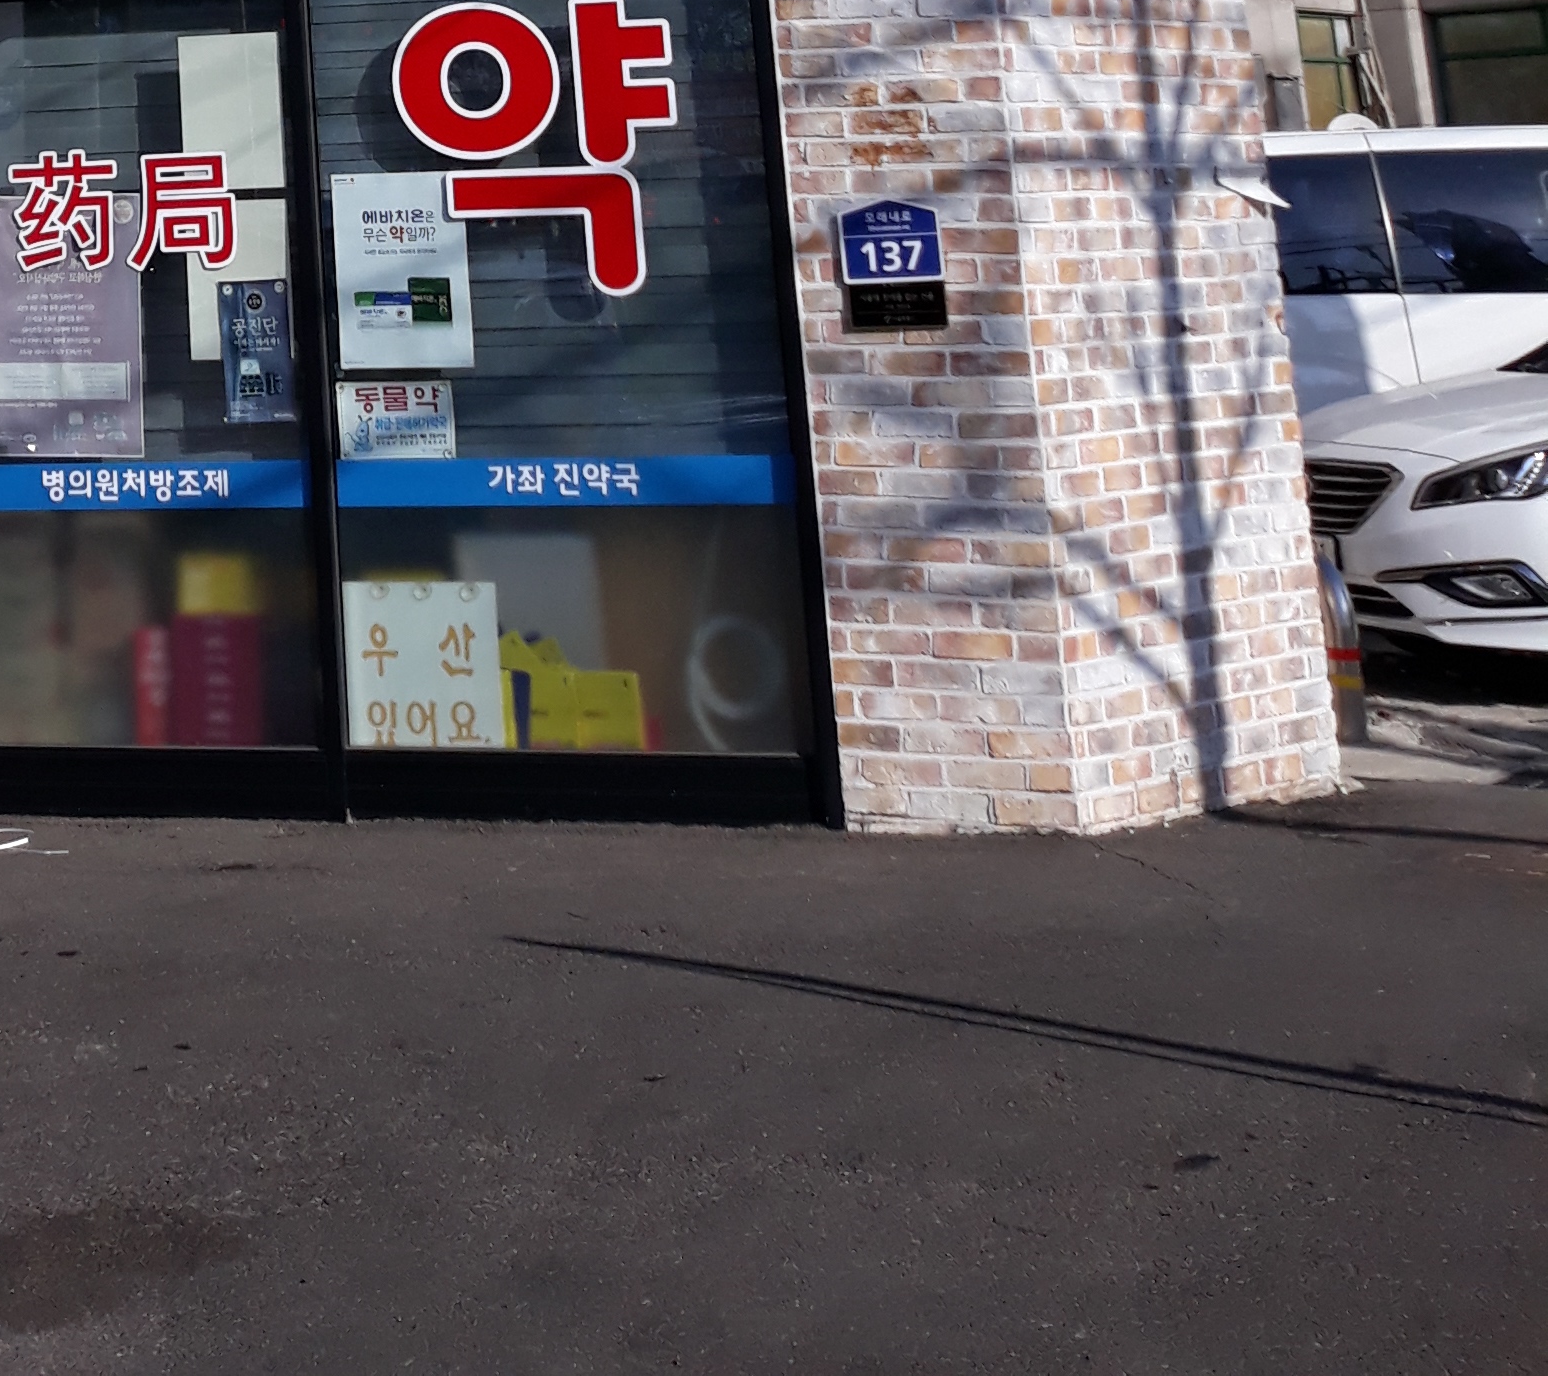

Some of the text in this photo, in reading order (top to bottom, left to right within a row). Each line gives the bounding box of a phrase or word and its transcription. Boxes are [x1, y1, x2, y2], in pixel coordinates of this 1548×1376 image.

[8, 148, 239, 272] 药局
[361, 209, 435, 224] 에바치온은
[362, 225, 437, 244] 무슨 약일까?
[860, 238, 923, 273] 137
[232, 316, 278, 339] 공진단
[41, 468, 230, 503] 병의원처방조제
[487, 462, 641, 497] 가좌 진약국
